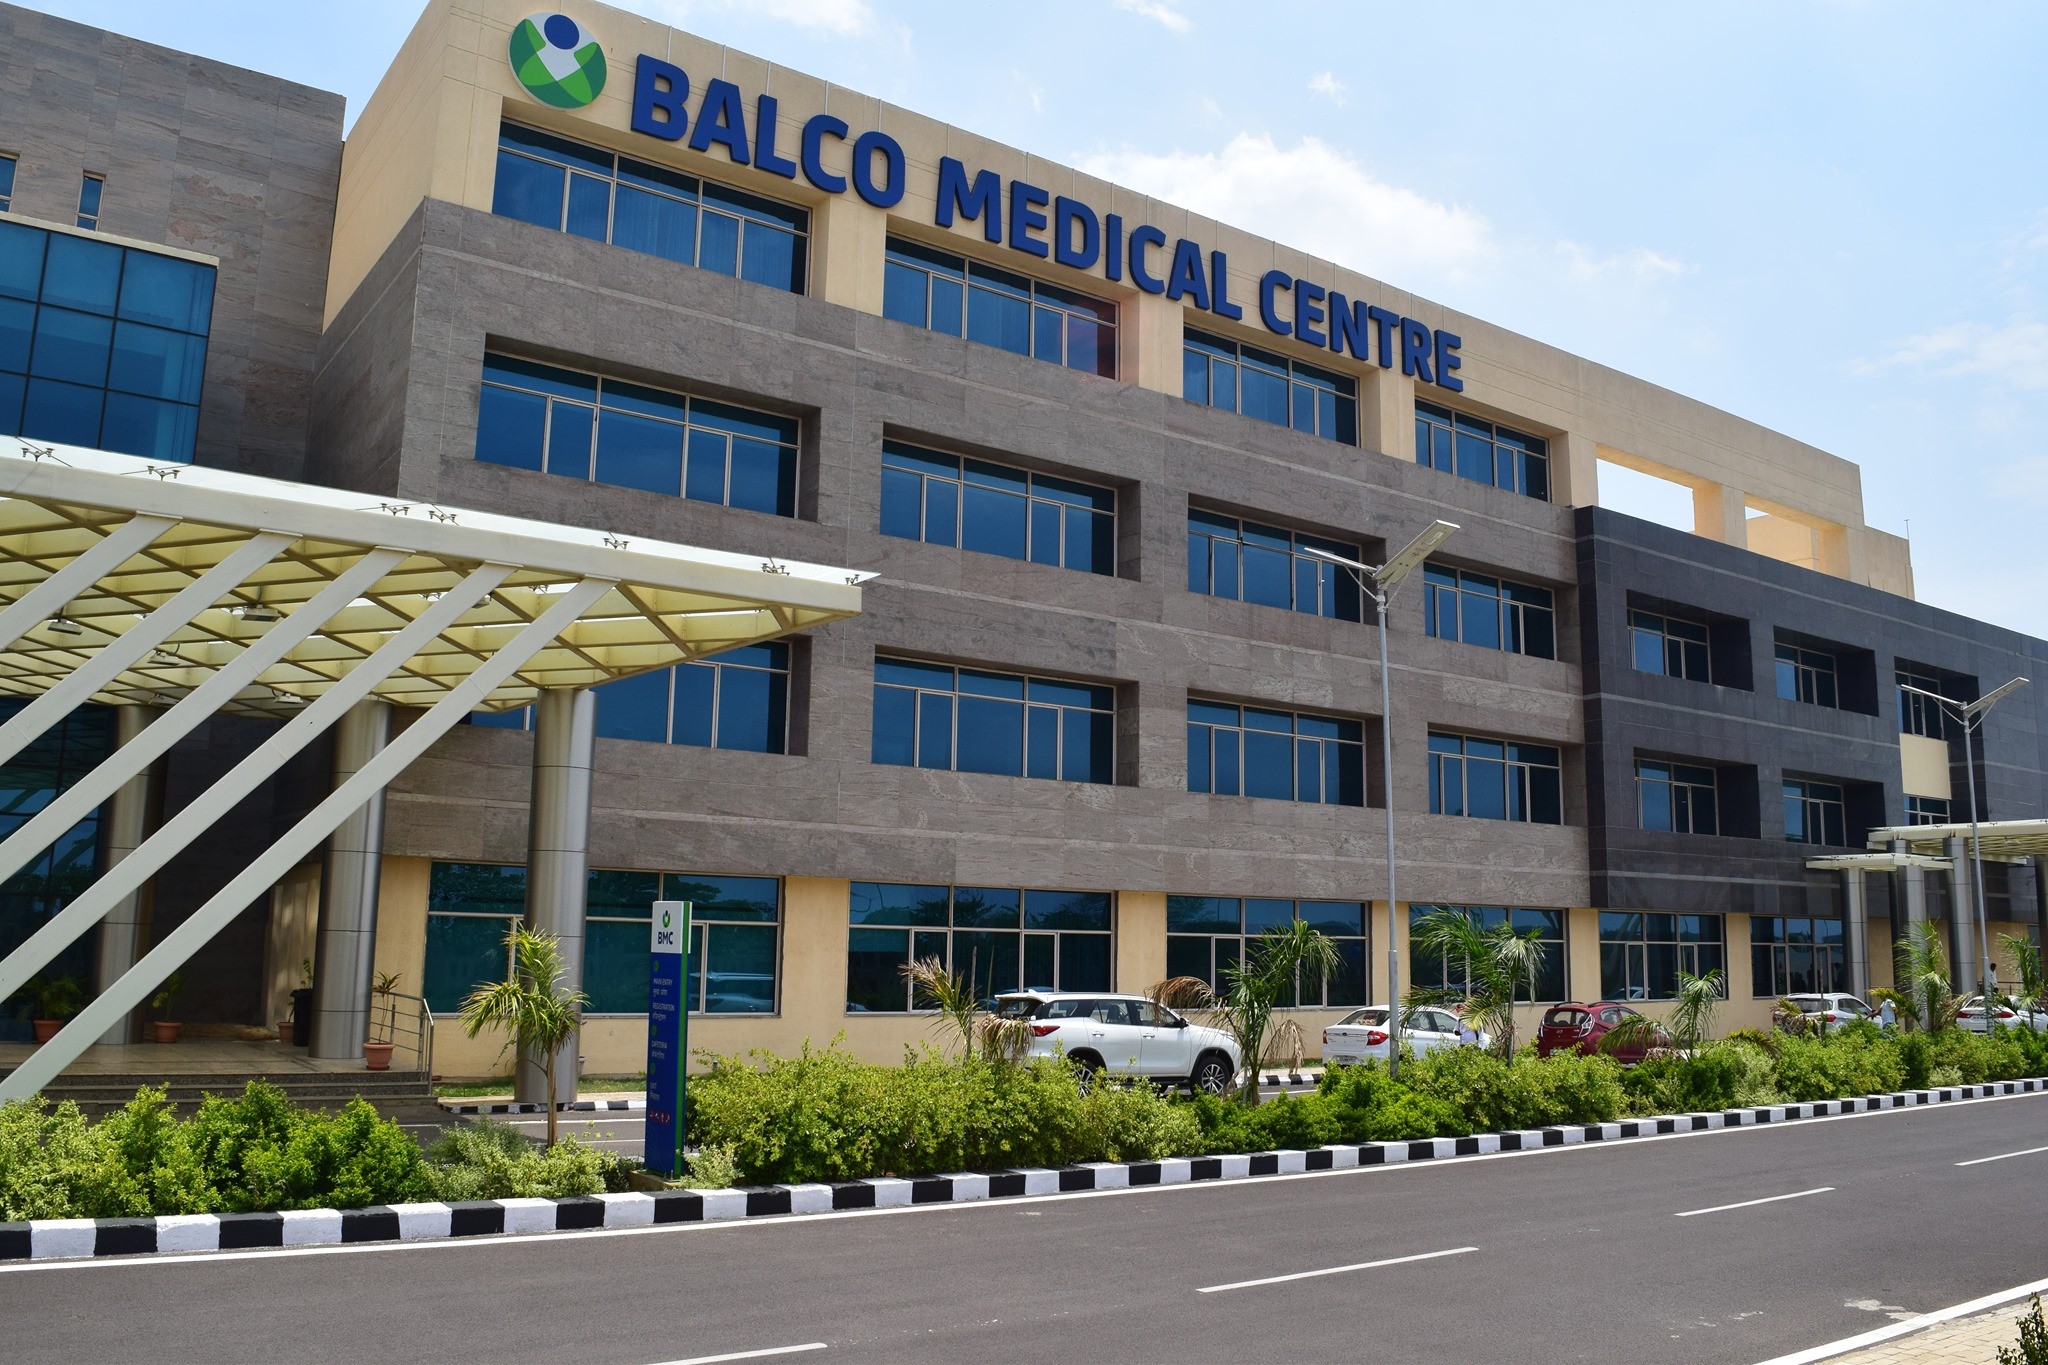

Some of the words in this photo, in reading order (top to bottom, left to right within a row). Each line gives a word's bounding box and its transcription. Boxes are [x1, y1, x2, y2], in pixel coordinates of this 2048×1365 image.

[631, 53, 906, 208] BALCO
[935, 156, 1243, 321] MEDICAL
[1259, 269, 1464, 393] CENTRE
[658, 931, 674, 945] BMC
